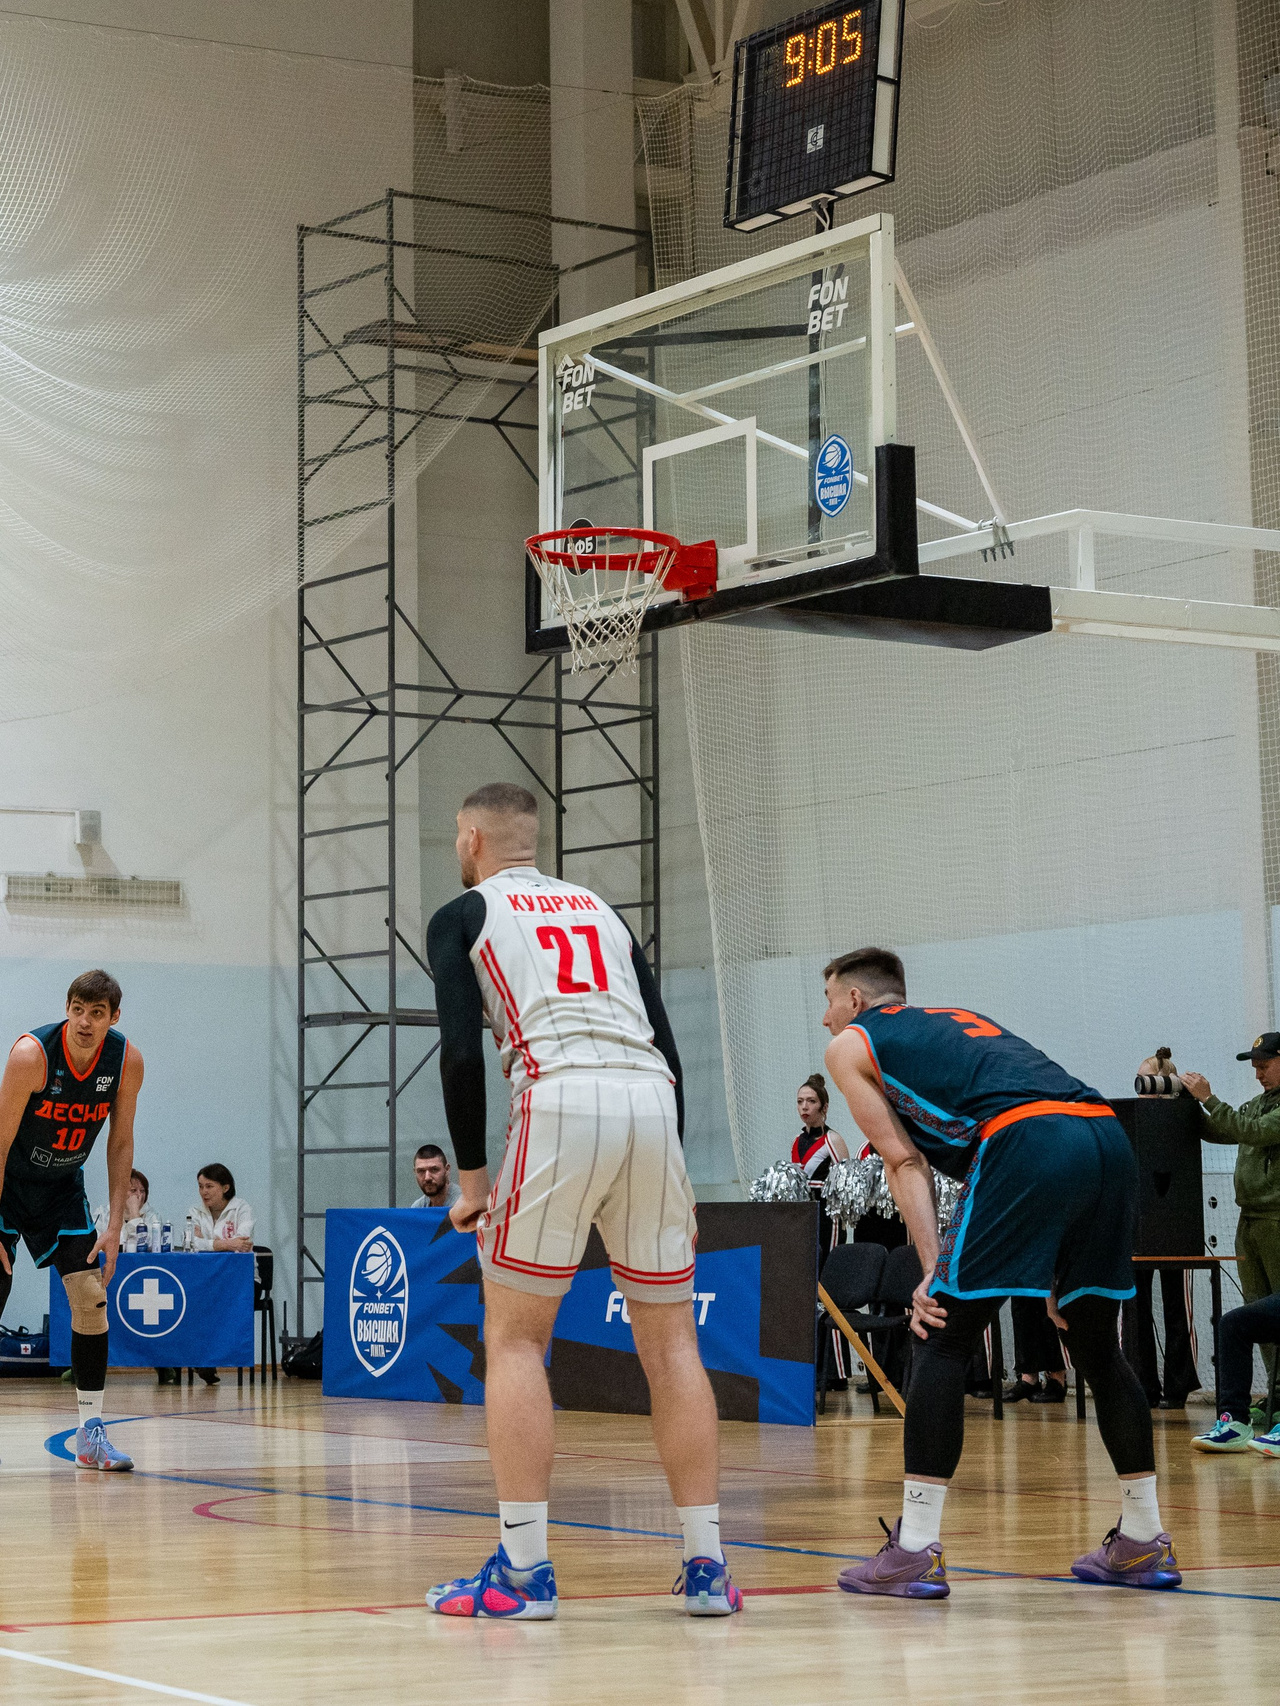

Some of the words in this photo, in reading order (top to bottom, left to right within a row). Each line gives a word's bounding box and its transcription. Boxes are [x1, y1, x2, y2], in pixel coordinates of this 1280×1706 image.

[786, 9, 862, 88] 9:05
[807, 276, 849, 309] FON
[807, 303, 849, 335] BET
[562, 361, 596, 392] FON
[562, 384, 596, 415] BET
[506, 894, 599, 913] КУДРИН
[536, 925, 609, 994] 27
[923, 1008, 1002, 1038] 3
[96, 1076, 114, 1084] FON
[51, 1127, 86, 1151] 10
[363, 1303, 395, 1315] FONBET
[357, 1319, 399, 1343] ВЫСШАЯ
